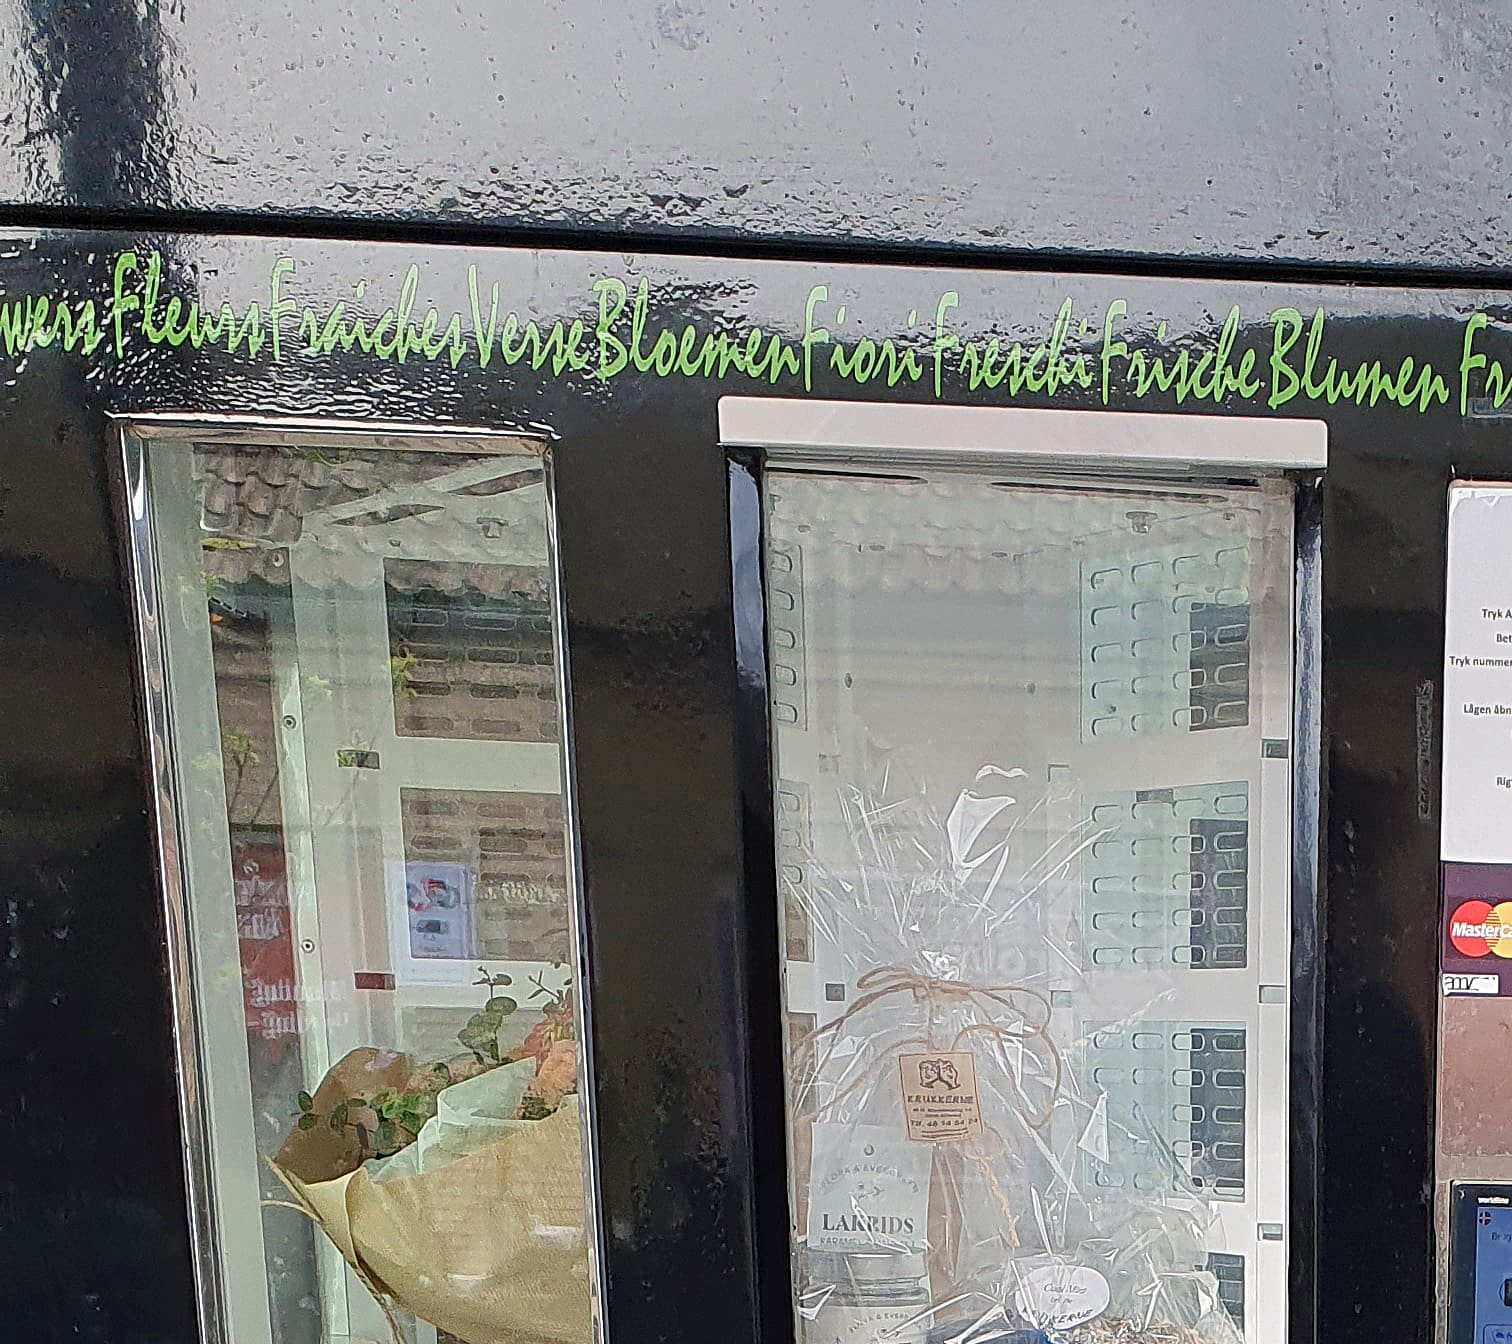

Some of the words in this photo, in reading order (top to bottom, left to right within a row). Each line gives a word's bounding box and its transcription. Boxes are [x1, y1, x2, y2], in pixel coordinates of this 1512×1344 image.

[112, 251, 265, 359] Fleurs
[468, 264, 590, 377] Verse
[593, 276, 800, 384] Bloemen
[801, 285, 923, 393] Fiori
[933, 291, 1093, 398] Freschi
[1100, 299, 1260, 406] Frische
[1269, 306, 1449, 414] Blumen
[1482, 608, 1503, 621] Tryk
[1505, 609, 1512, 619] A
[1449, 655, 1470, 668] Tryk
[1463, 703, 1491, 716] Lågen
[822, 1213, 914, 1235] LAKRIDS
